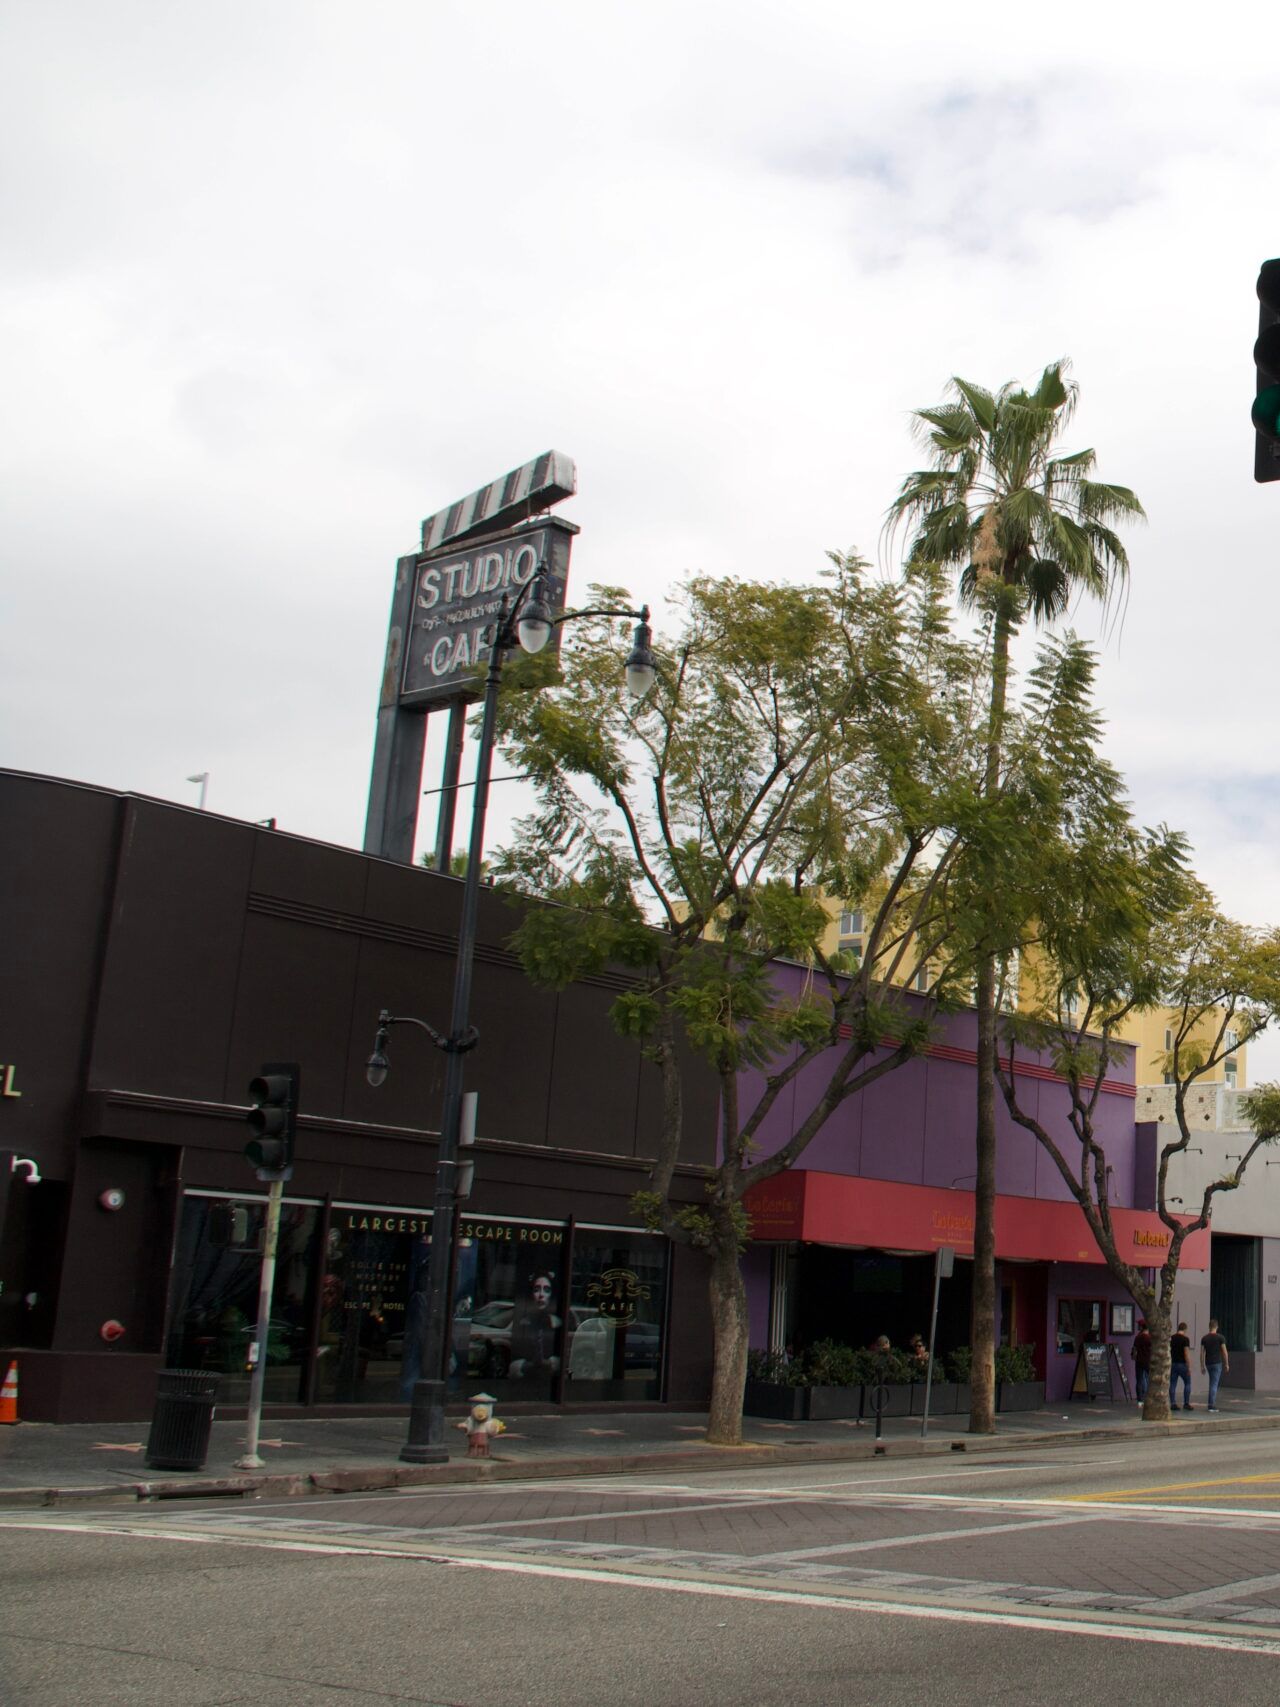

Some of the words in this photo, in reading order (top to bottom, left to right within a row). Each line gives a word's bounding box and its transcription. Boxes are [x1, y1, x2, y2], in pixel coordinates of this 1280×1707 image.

[417, 544, 538, 609] STUDIO
[431, 624, 497, 676] CAF
[348, 1215, 429, 1233] LARGEST
[458, 1223, 512, 1241] ESCAPE
[519, 1230, 564, 1244] ROOM
